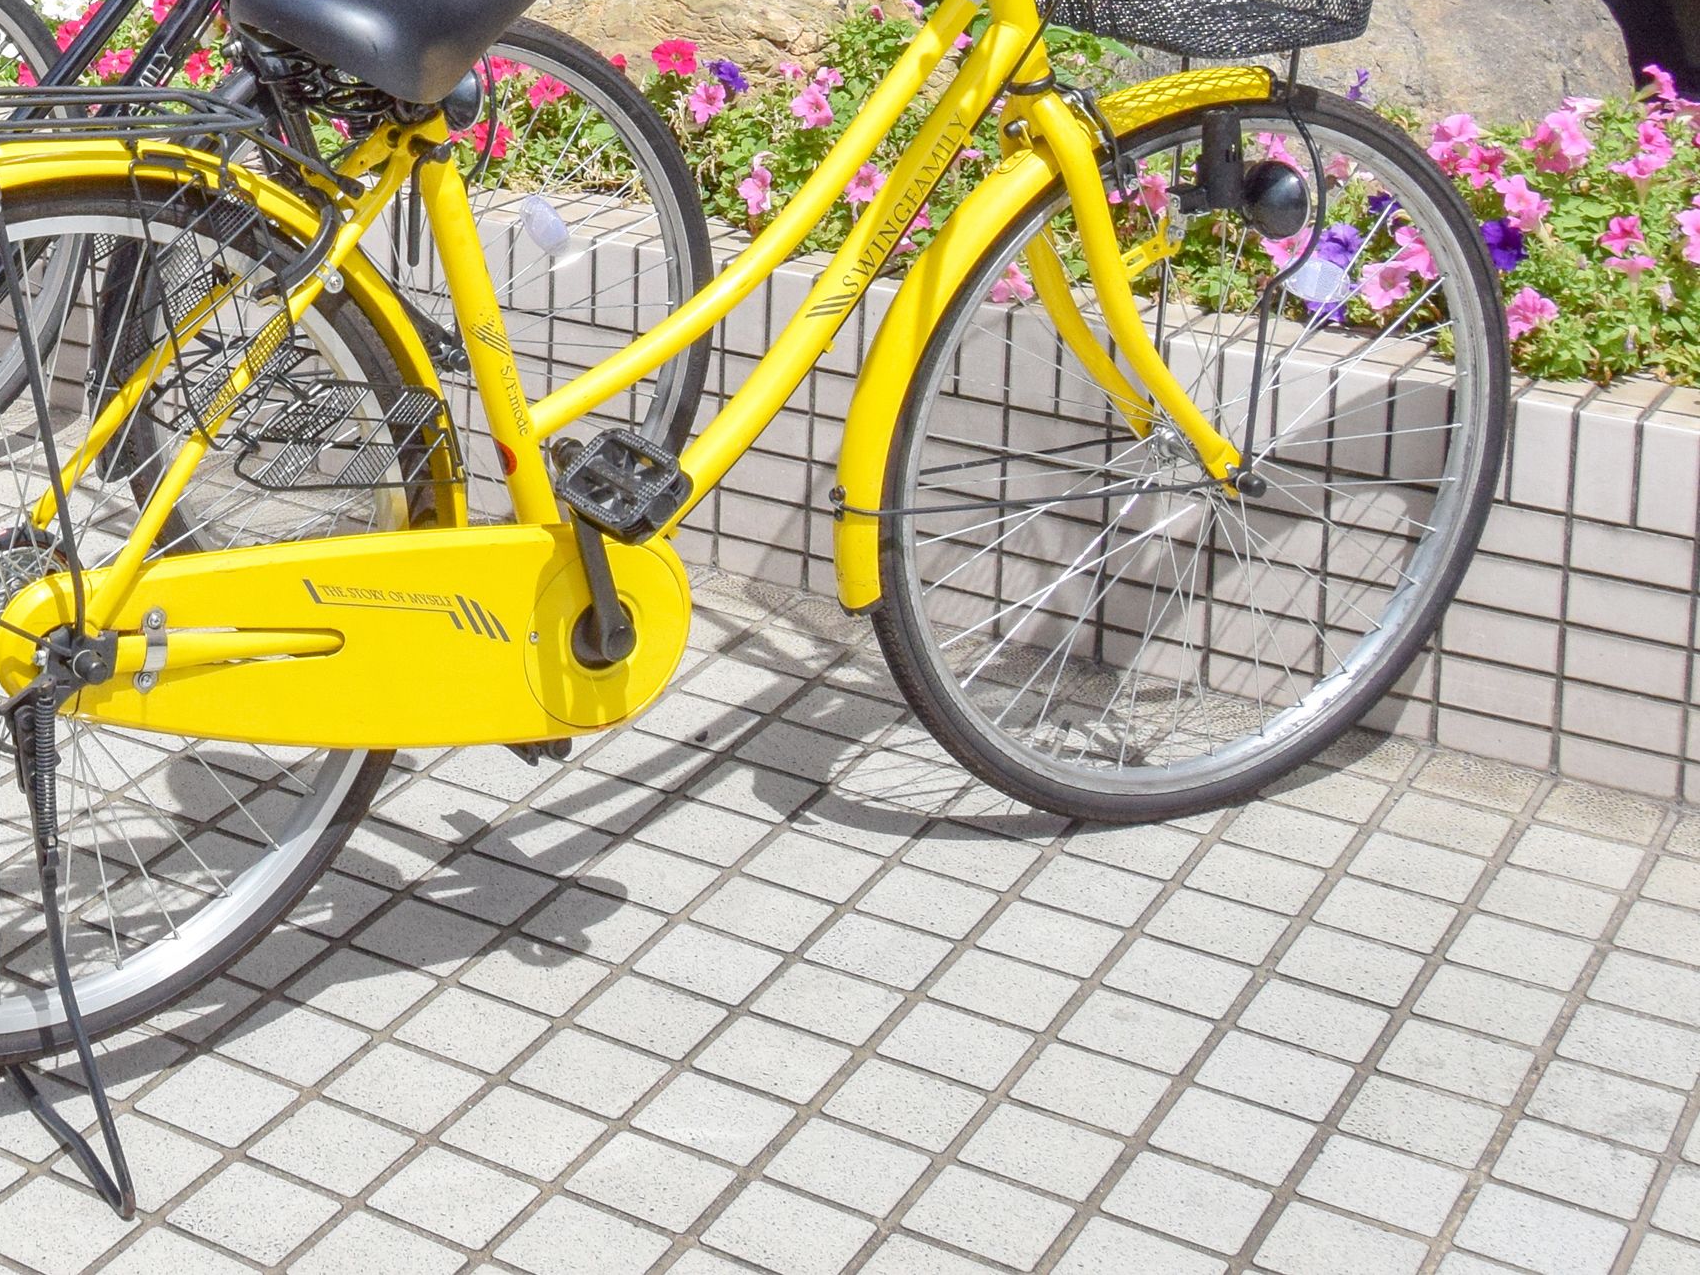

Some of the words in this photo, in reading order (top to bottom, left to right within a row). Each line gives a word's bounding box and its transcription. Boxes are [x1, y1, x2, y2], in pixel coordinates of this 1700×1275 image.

[842, 110, 968, 297] SWINGFAMILY
[317, 584, 348, 598] THE
[347, 587, 387, 602] STORY
[388, 591, 405, 603] OF
[407, 593, 453, 607] MYSELF
